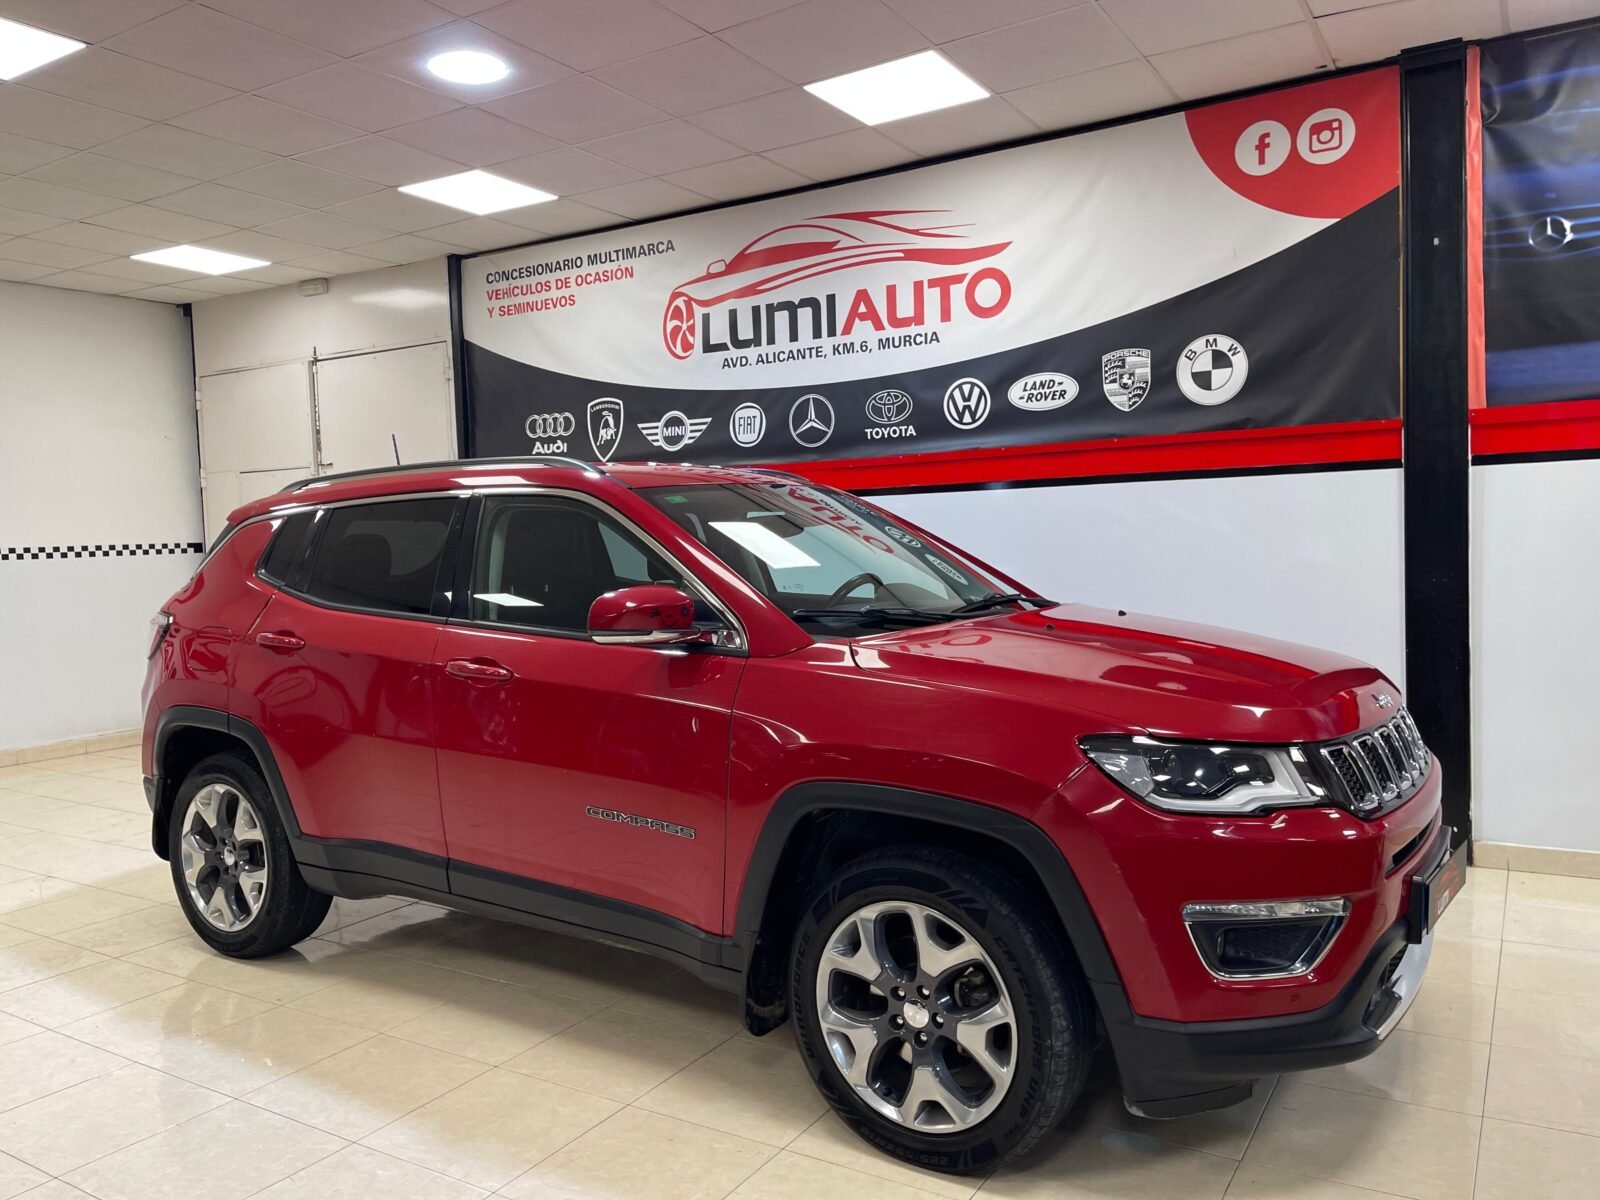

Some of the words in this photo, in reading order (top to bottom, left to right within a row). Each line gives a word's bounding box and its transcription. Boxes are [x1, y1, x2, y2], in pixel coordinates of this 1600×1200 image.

[486, 256, 583, 284] CONCESIONARIO
[587, 239, 676, 267] MULTIMARCA
[486, 280, 552, 301] VEHÍCULOS
[555, 276, 572, 291] DE
[574, 265, 634, 287] OCASIÓN
[487, 306, 495, 319] Y
[498, 294, 576, 317] SEMINUEVOS
[721, 355, 752, 370] AVD.
[755, 345, 828, 366] ALICANTE,
[832, 340, 873, 357] KM.6,
[878, 331, 941, 351] MURCIA
[1103, 350, 1150, 363] PORSCHE
[1184, 337, 1242, 362] BMW
[662, 425, 686, 437] MINI
[737, 414, 758, 436] FIAT
[864, 425, 917, 440] TOYOTA
[531, 439, 568, 455] Audi
[585, 805, 695, 840] COMPASS
